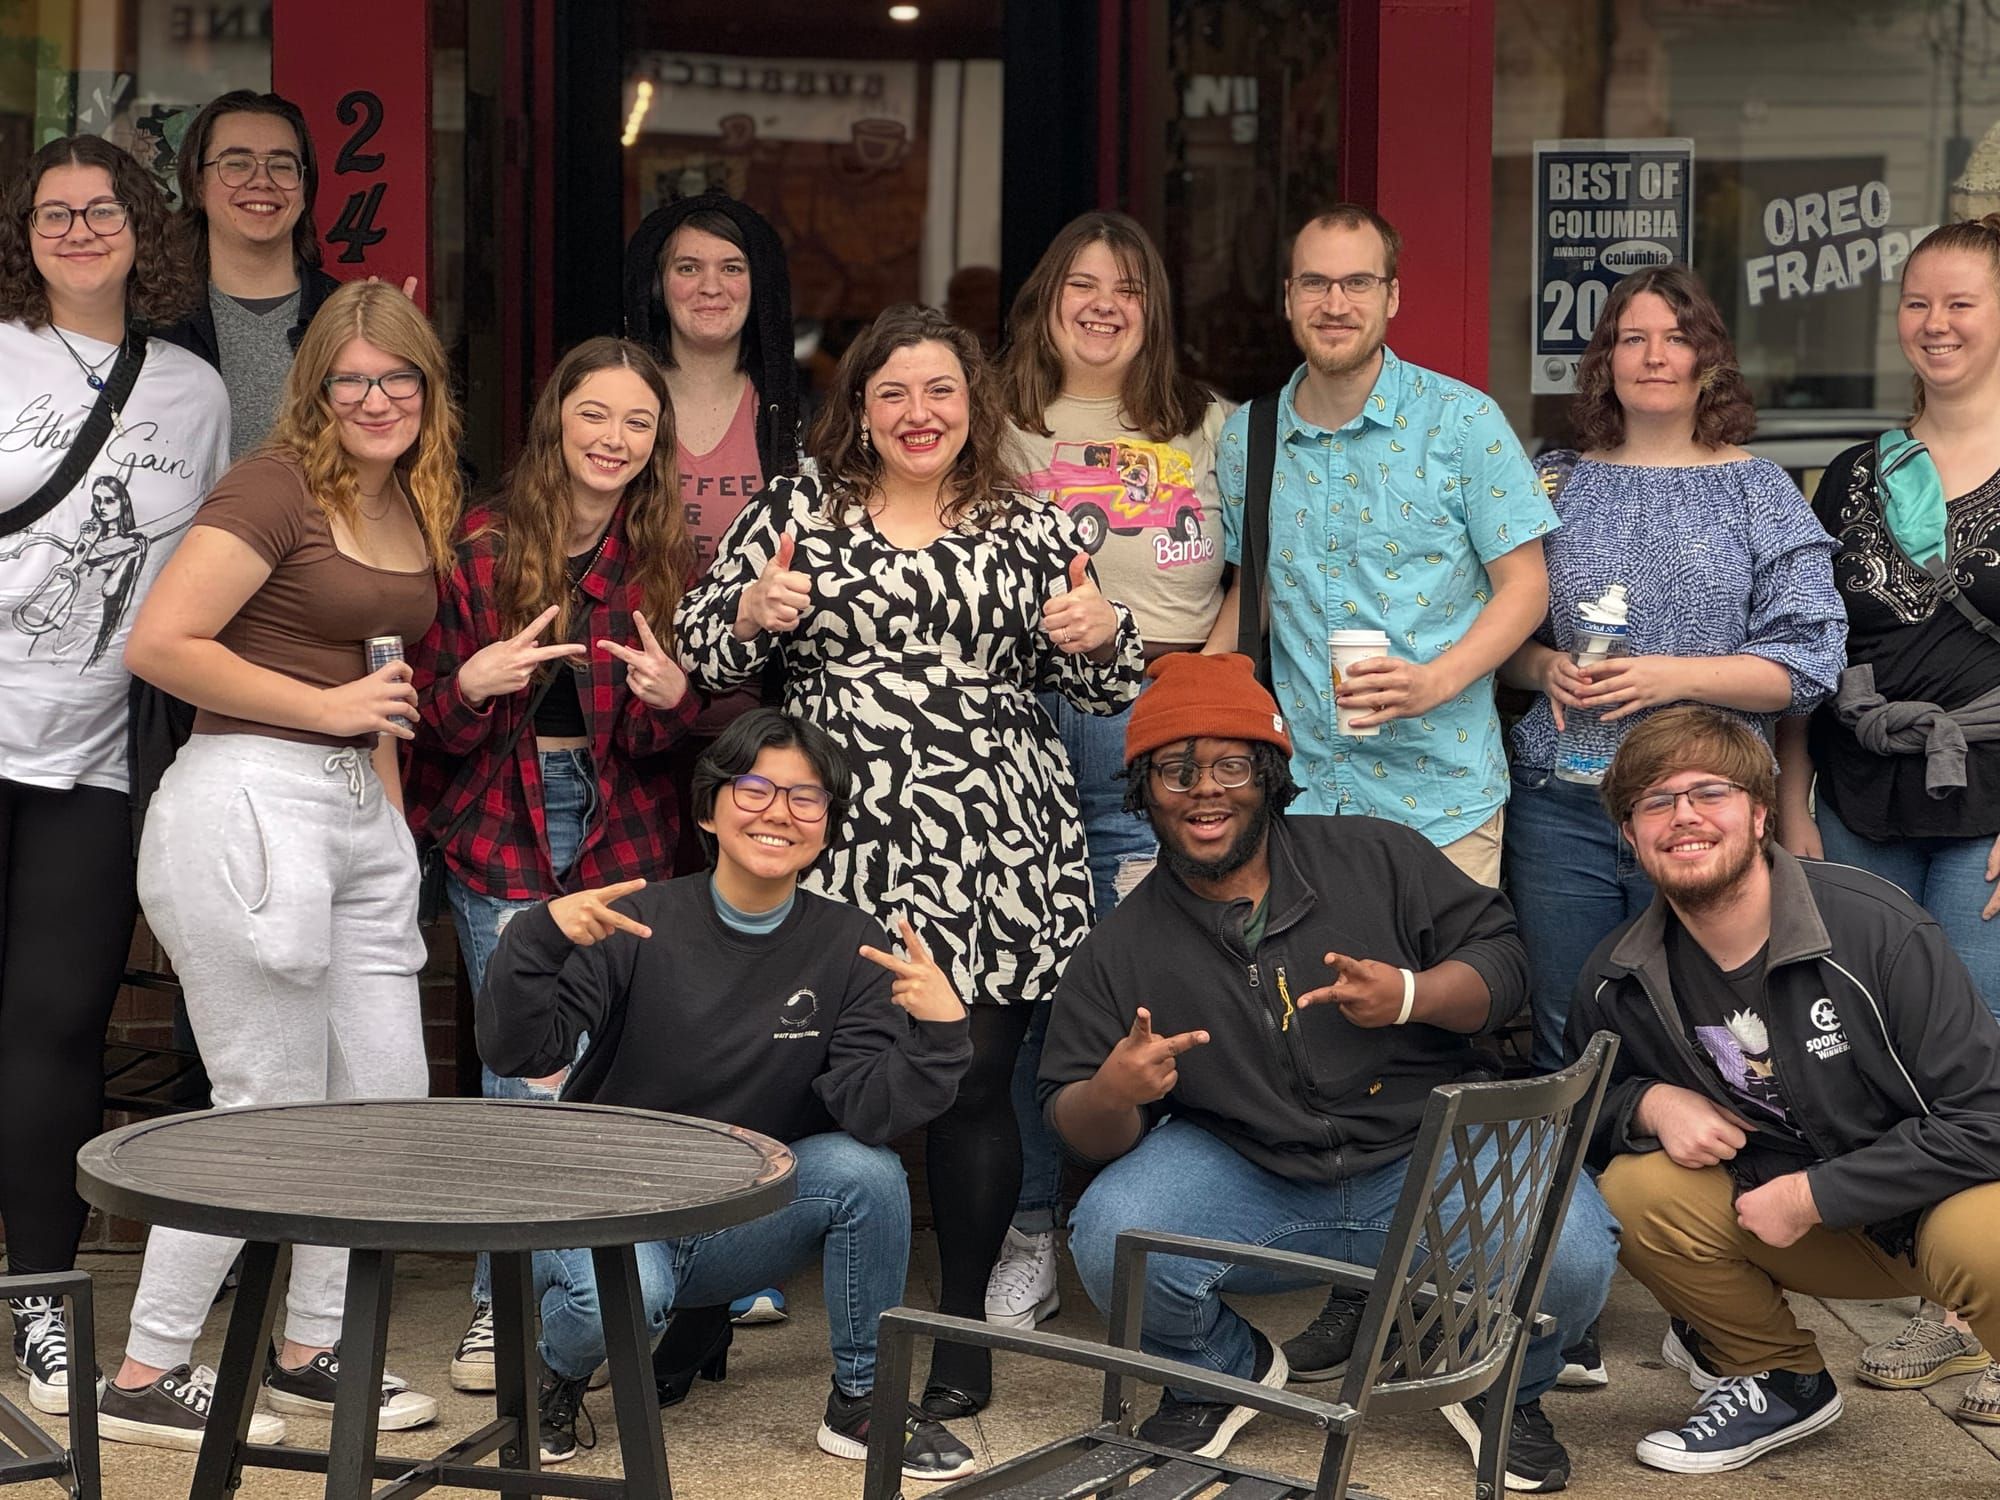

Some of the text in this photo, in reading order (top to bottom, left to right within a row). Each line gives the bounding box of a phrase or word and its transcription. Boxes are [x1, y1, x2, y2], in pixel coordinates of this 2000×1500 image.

[1549, 162, 1680, 200] BEST OF
[1549, 210, 1678, 238] COLUMBIA
[1764, 181, 1891, 246] OREO
[1553, 247, 1596, 257] AWARDED
[1583, 260, 1595, 271] BY
[1605, 251, 1668, 265] columbia
[1543, 280, 1622, 341] 20
[0, 394, 86, 452] Ethe
[1153, 534, 1214, 565] Barbie
